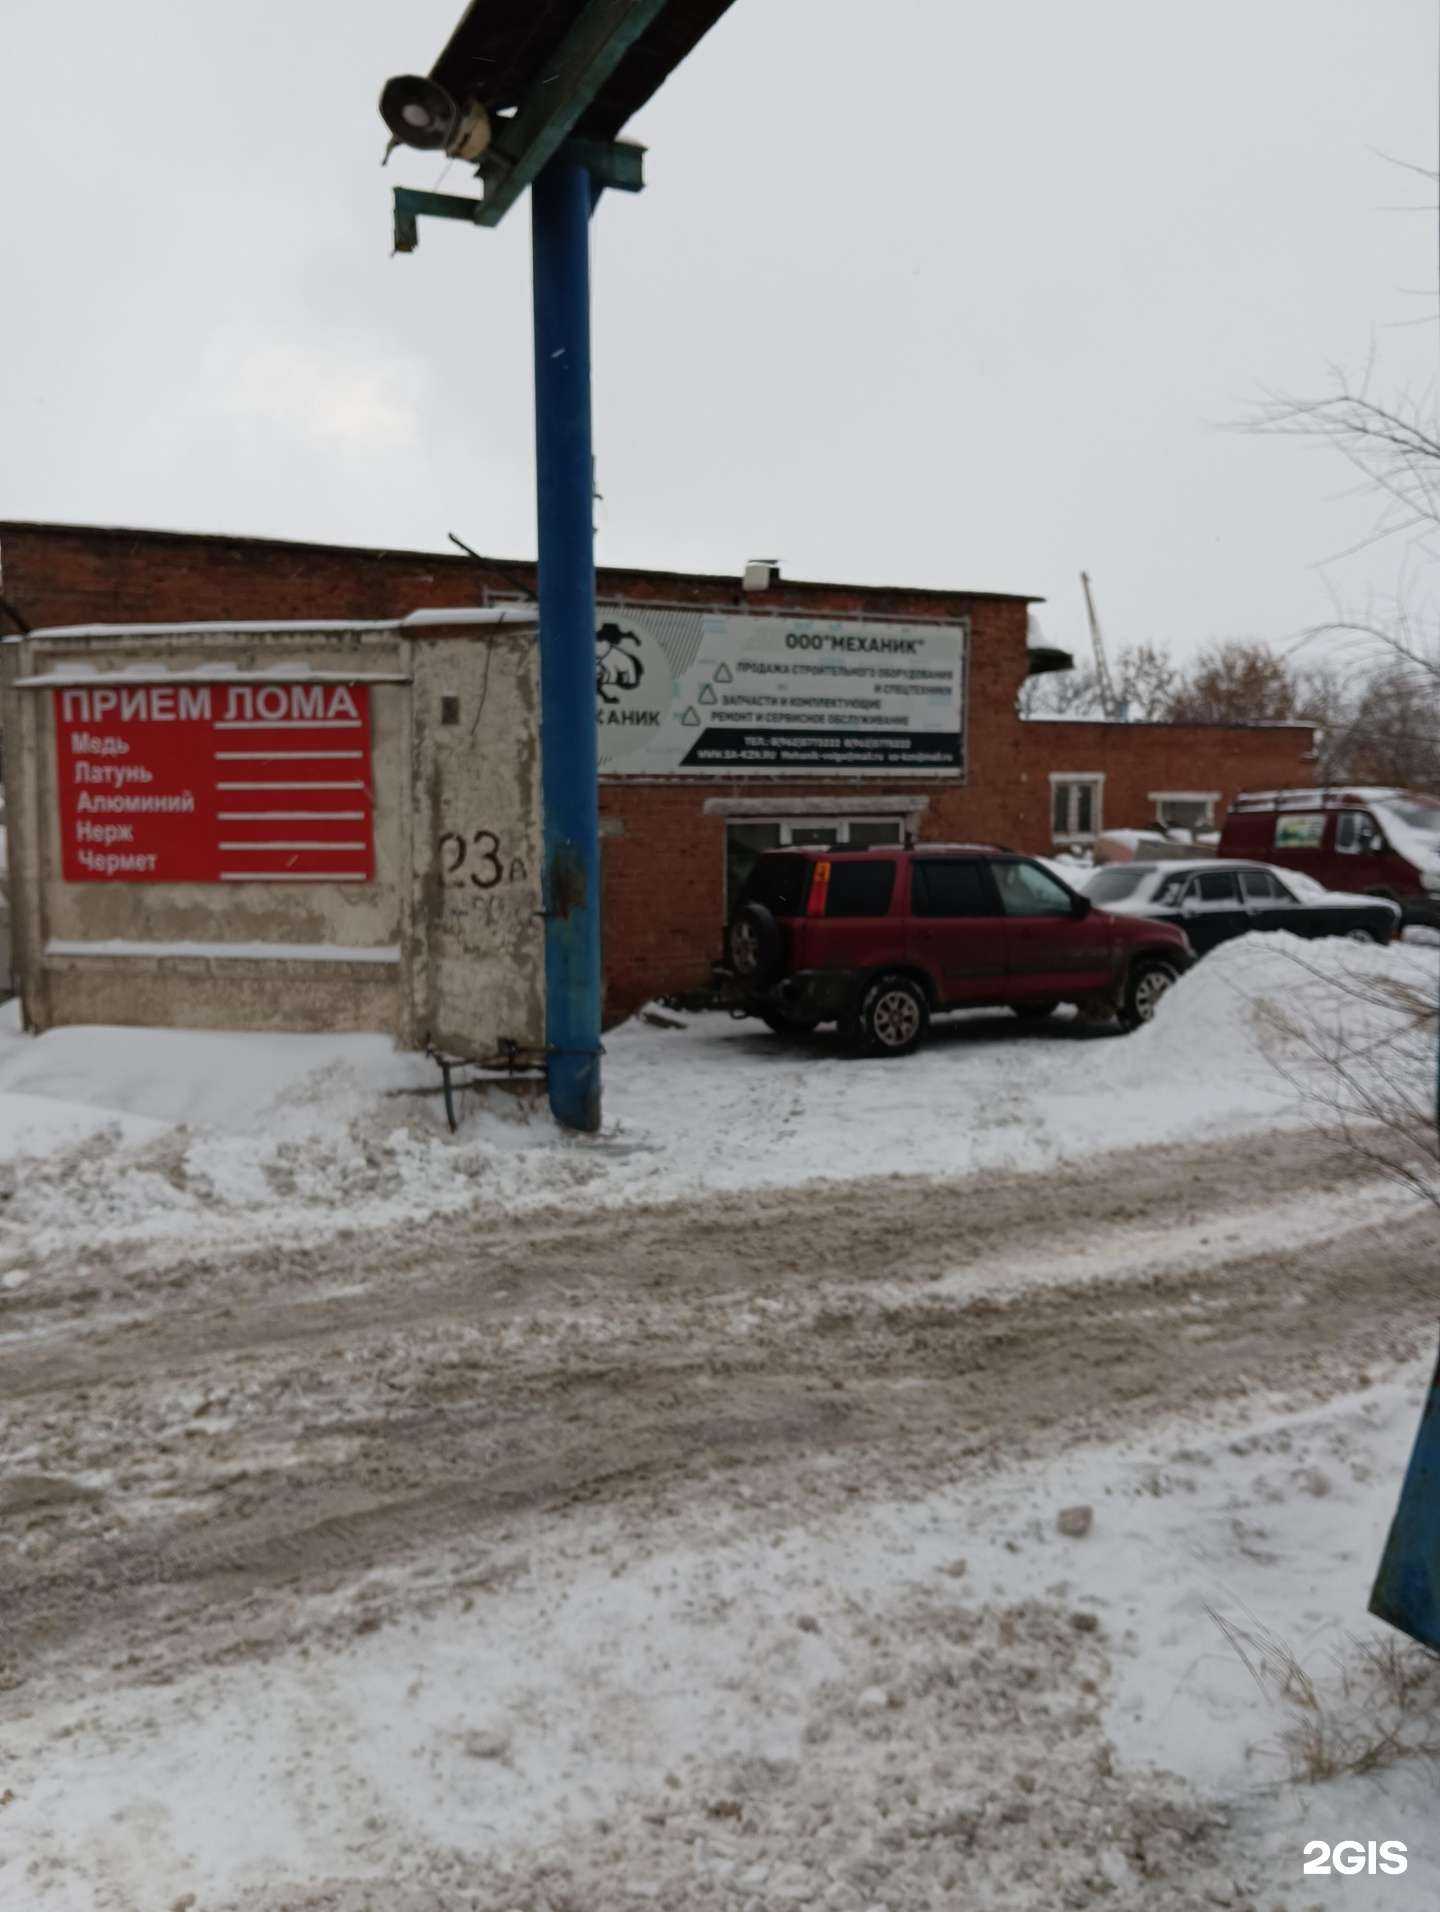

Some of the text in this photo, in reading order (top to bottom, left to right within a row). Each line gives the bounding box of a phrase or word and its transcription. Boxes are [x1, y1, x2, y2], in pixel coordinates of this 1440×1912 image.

[62, 686, 358, 722] ПРИЕМ ЛОМА
[71, 732, 129, 755] Медь
[74, 761, 152, 787] Латунь
[77, 790, 194, 813] Алюминий
[76, 821, 134, 846] Нерж
[78, 850, 157, 875] Чермет
